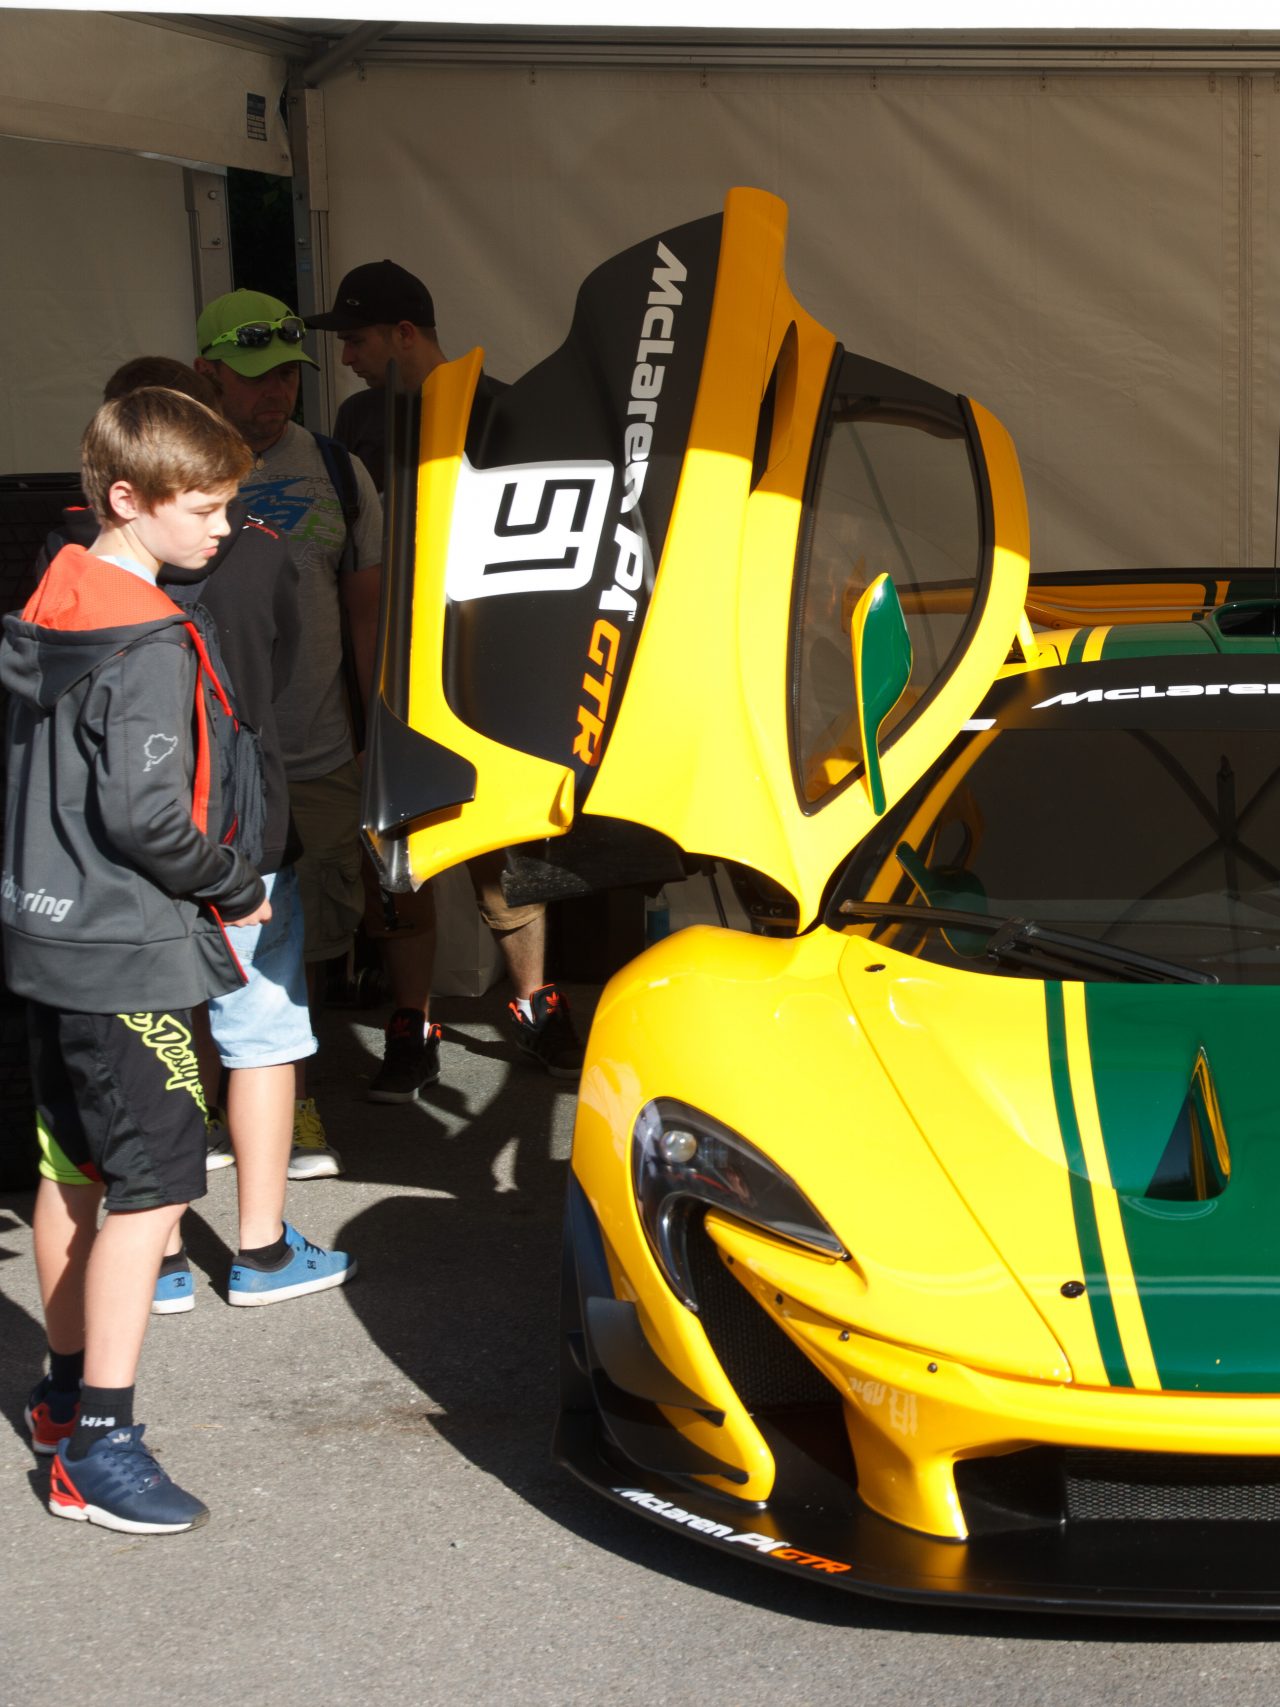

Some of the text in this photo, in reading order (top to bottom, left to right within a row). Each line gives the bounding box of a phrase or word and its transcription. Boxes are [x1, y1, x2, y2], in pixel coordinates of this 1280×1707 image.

[620, 240, 688, 514] McLaren
[483, 479, 596, 576] 51
[573, 619, 621, 767] GTR
[611, 1488, 734, 1538] McLaren
[770, 1548, 852, 1574] GTR
